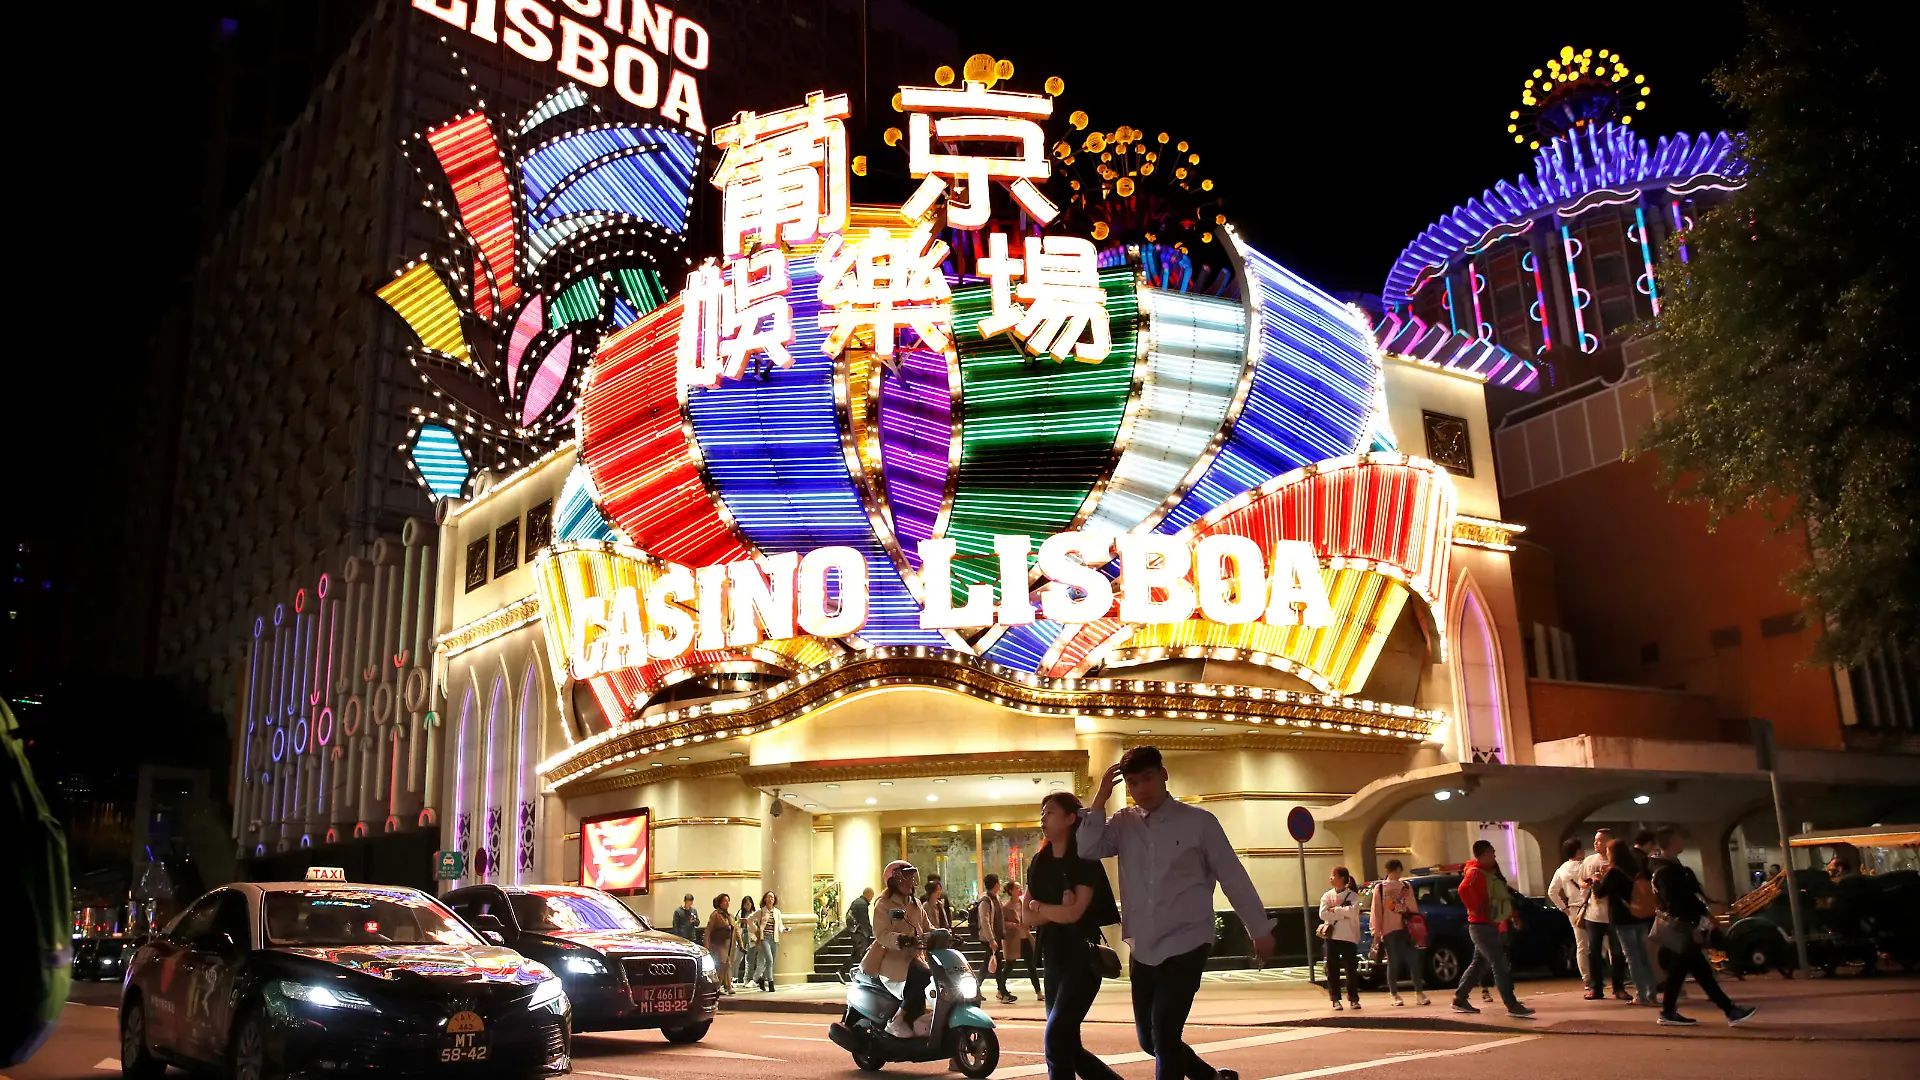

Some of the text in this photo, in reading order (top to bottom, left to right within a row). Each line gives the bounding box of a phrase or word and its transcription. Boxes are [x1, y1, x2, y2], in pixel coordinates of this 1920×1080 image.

[570, 531, 1334, 680] CASINO LISBOA
[313, 869, 343, 879] TAXI
[455, 1033, 476, 1048] MT
[441, 1046, 487, 1062] 58-42
